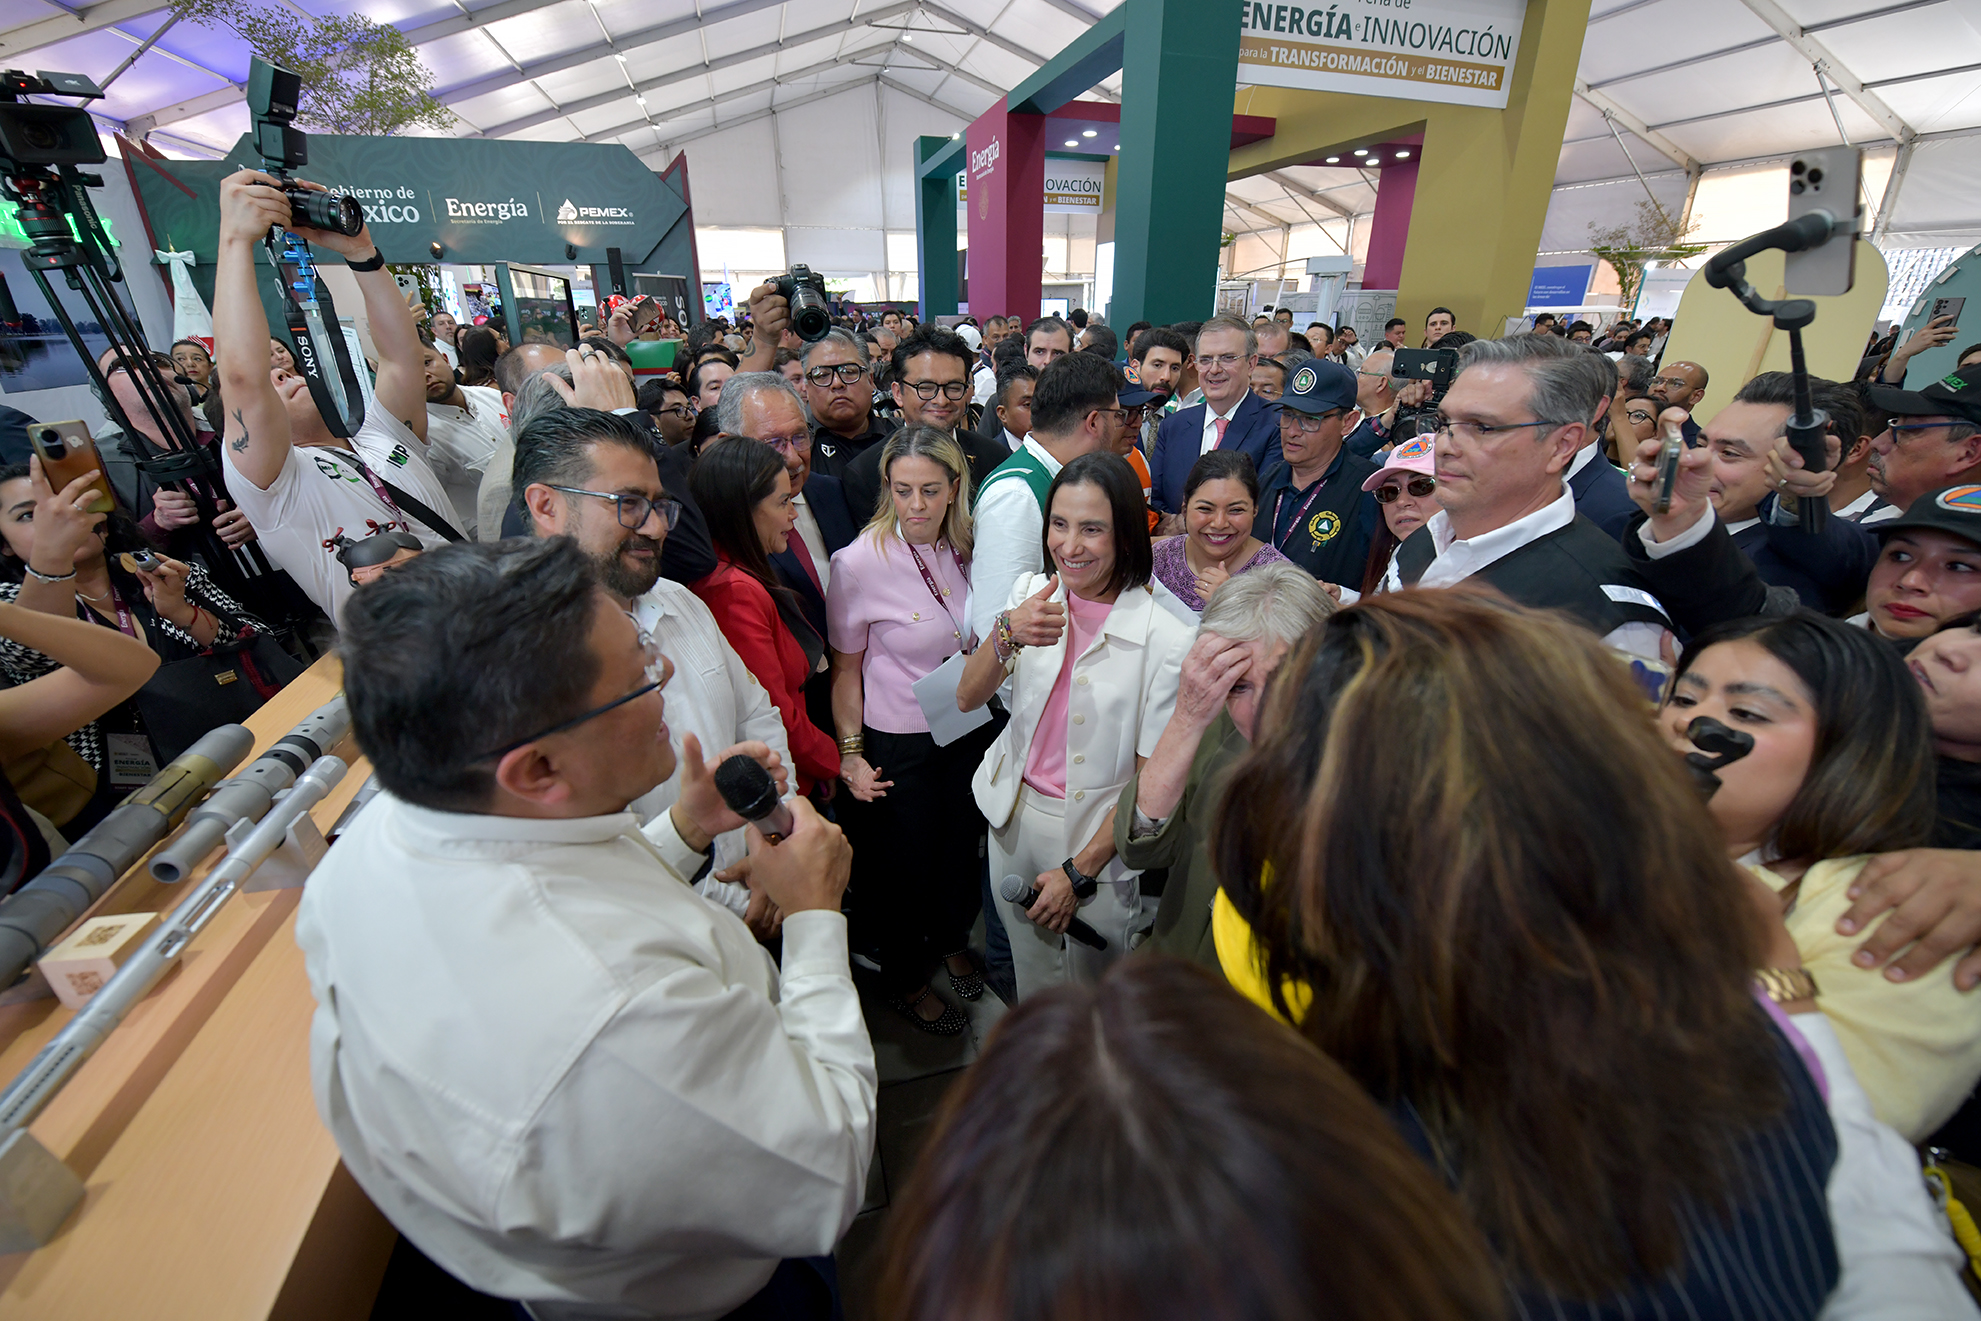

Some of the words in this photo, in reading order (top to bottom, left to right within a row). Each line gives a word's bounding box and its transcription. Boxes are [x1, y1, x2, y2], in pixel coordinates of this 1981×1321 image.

[1241, 0, 1353, 41] ENERGÍA
[1355, 23, 1361, 31] e
[1361, 16, 1512, 60] INNOVACIÓN
[1239, 48, 1258, 58] para
[1260, 48, 1268, 59] la
[1270, 46, 1408, 77] TRANSFORMACIÓN
[1411, 65, 1417, 77] y
[1417, 66, 1425, 75] el
[1426, 64, 1498, 87] BIENESTAR
[972, 135, 1000, 173] Energía
[322, 185, 393, 199] obierno
[396, 186, 416, 199] de
[1045, 177, 1101, 193] OVACIÓN
[72, 184, 98, 230] Panasonic
[361, 199, 420, 223] xico
[445, 198, 529, 220] Energía
[579, 207, 628, 217] PEMEX
[1058, 195, 1097, 205] BIENESTAR
[297, 335, 319, 379] SONY
[1943, 373, 1969, 390] MEX
[386, 444, 410, 469] IMP
